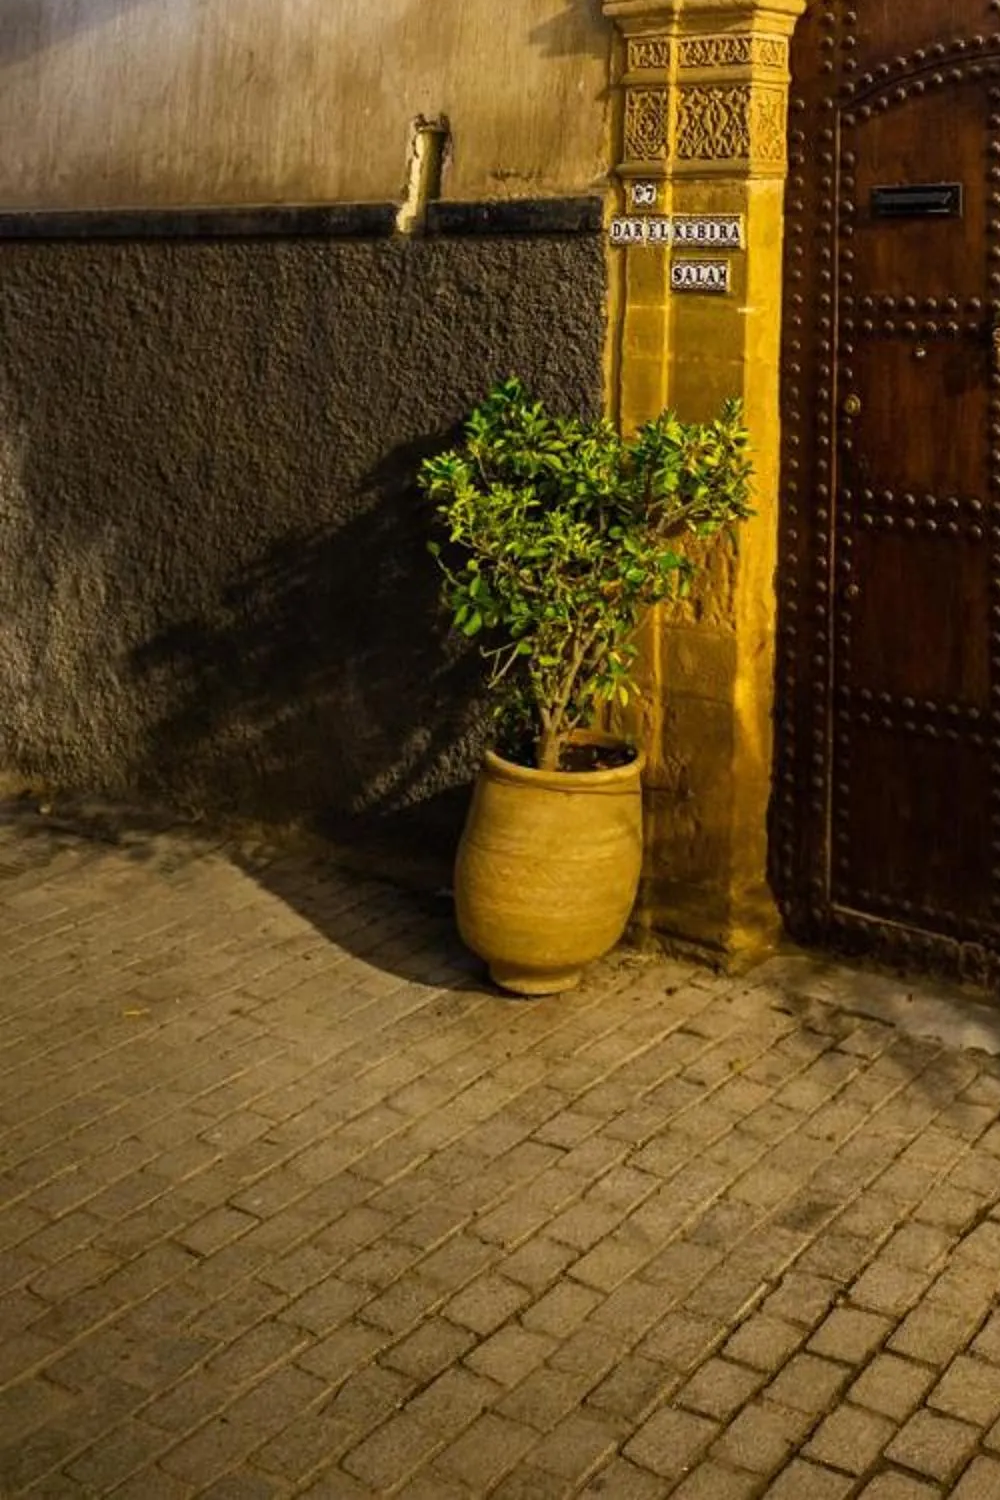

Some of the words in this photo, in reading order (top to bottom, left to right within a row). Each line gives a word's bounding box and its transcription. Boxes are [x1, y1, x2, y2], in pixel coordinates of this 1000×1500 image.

[613, 223, 643, 238] DAR
[648, 224, 668, 239] EL
[673, 224, 739, 240] KEBIRA
